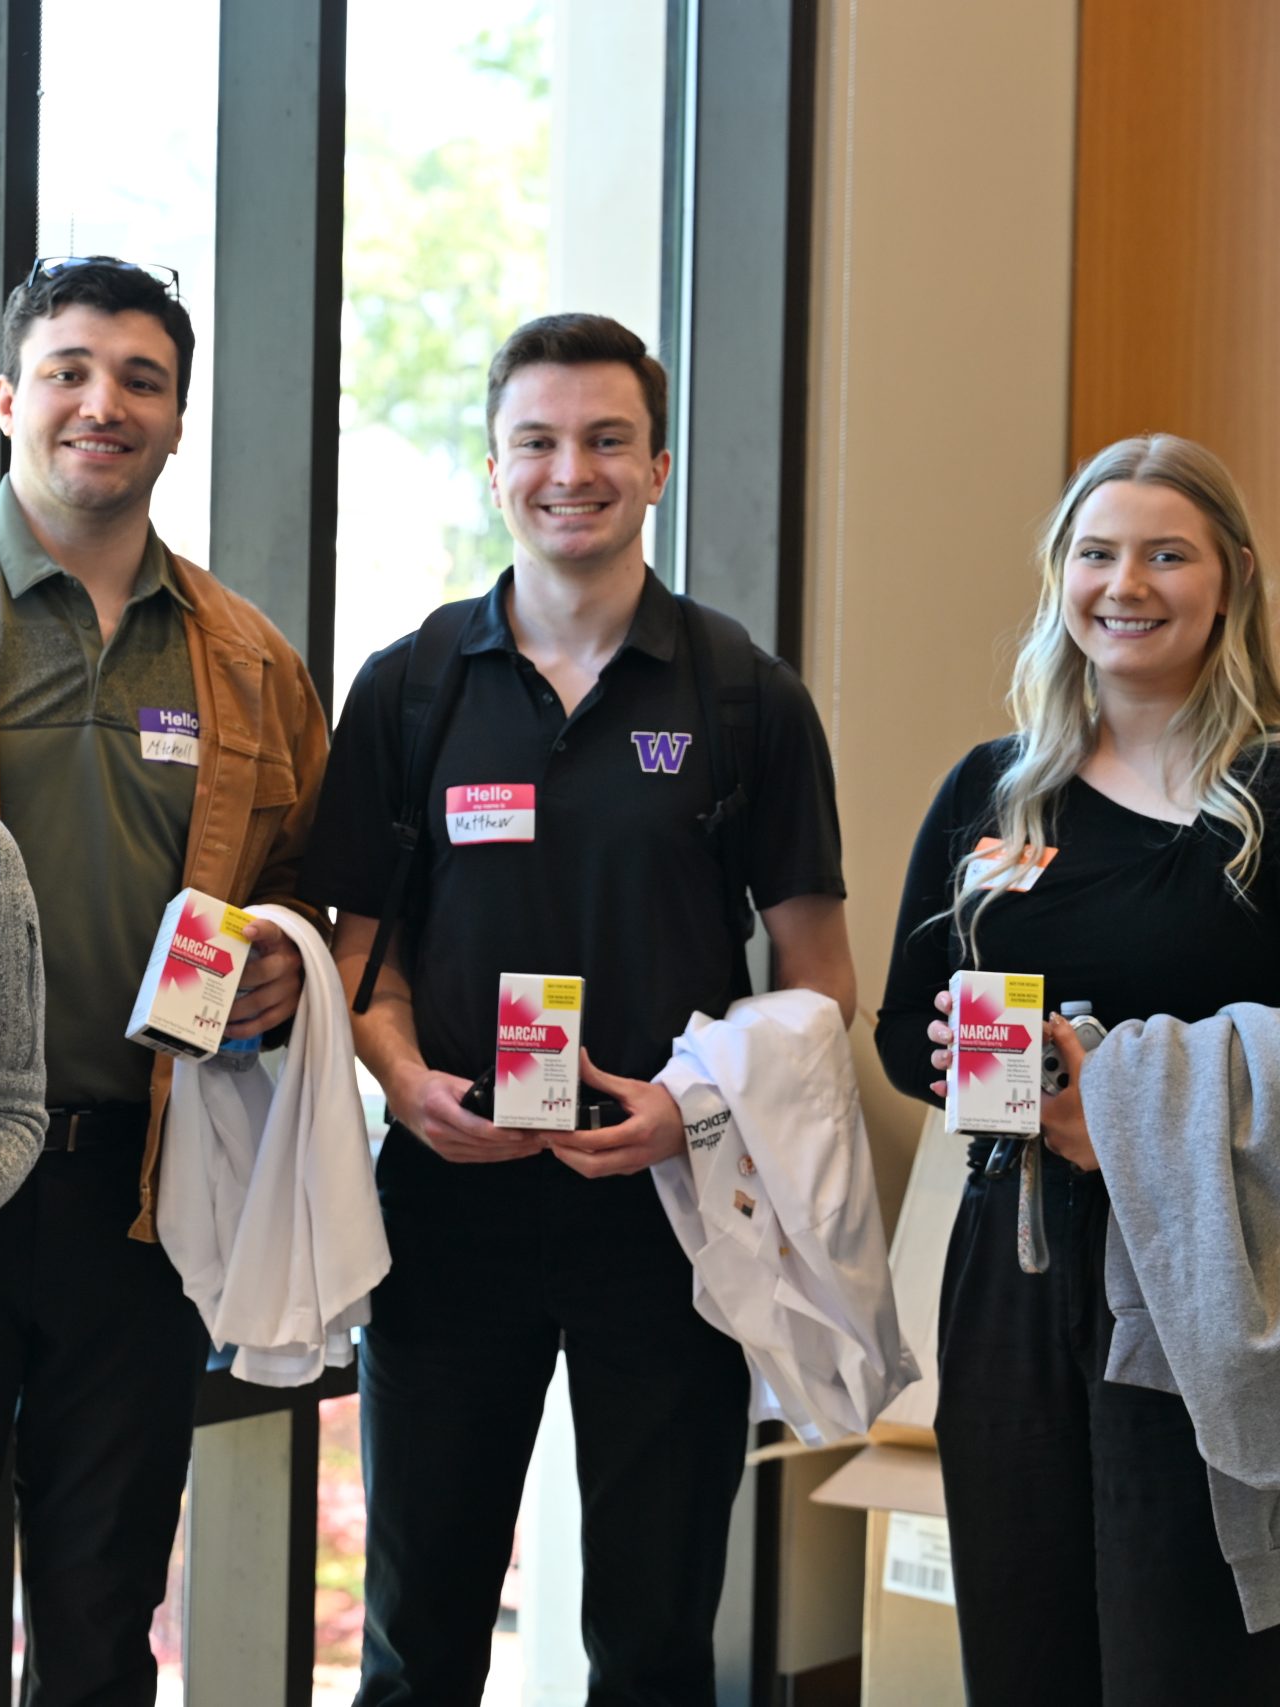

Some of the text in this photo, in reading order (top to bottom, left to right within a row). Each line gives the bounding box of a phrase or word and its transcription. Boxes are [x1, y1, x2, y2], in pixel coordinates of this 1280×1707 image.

[160, 710, 198, 729] Hello
[631, 731, 692, 774] W
[467, 786, 512, 802] Hello
[173, 933, 217, 962] NARCAN
[500, 1025, 546, 1042] NARCAN
[960, 1024, 1008, 1041] NARCAN
